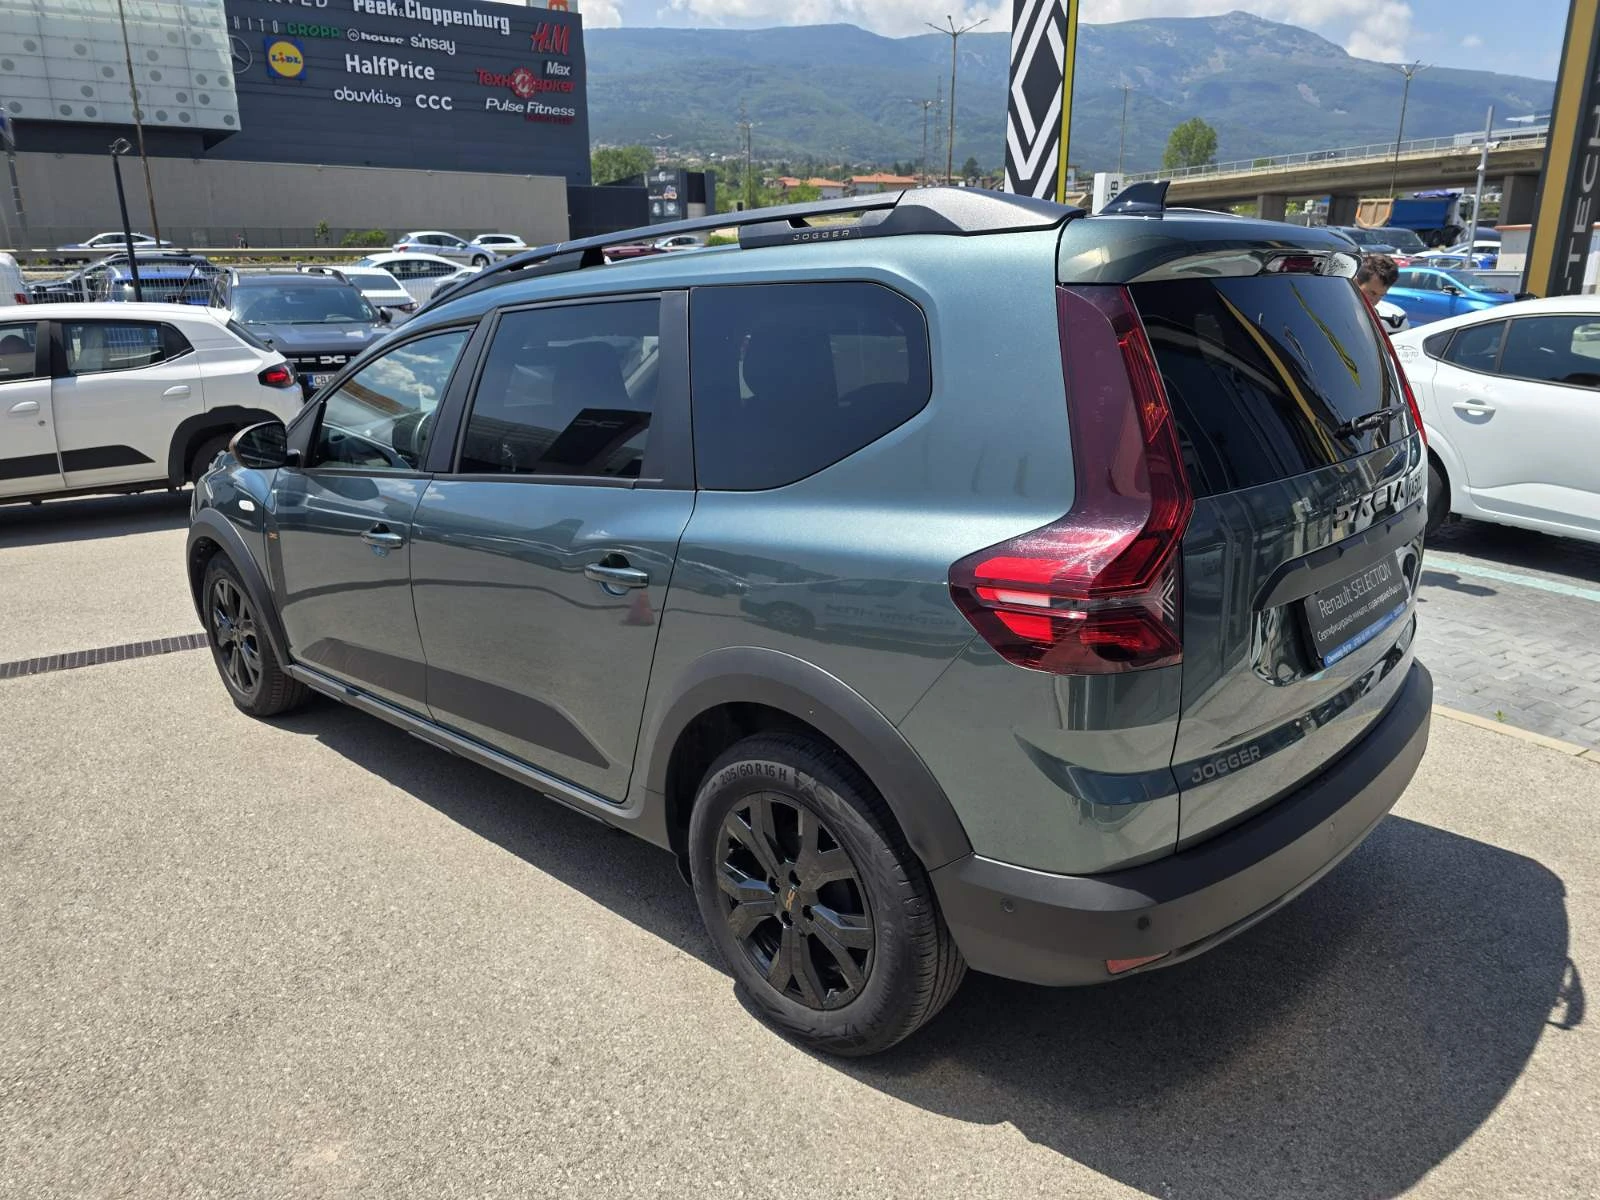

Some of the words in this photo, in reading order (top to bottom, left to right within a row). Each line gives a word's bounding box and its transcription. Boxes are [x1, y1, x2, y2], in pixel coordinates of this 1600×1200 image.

[287, 22, 341, 37] CROPP
[345, 53, 435, 80] HalfPrice
[546, 61, 571, 76] Max
[334, 86, 402, 108] obuvki.bg
[415, 94, 453, 110] CCC
[485, 98, 524, 113] Pulse
[527, 101, 576, 117] Fitness
[793, 229, 850, 241] JOGGER
[1318, 584, 1353, 618] Renault
[1350, 561, 1393, 599] SELECTION
[1191, 745, 1262, 783] JOGGER
